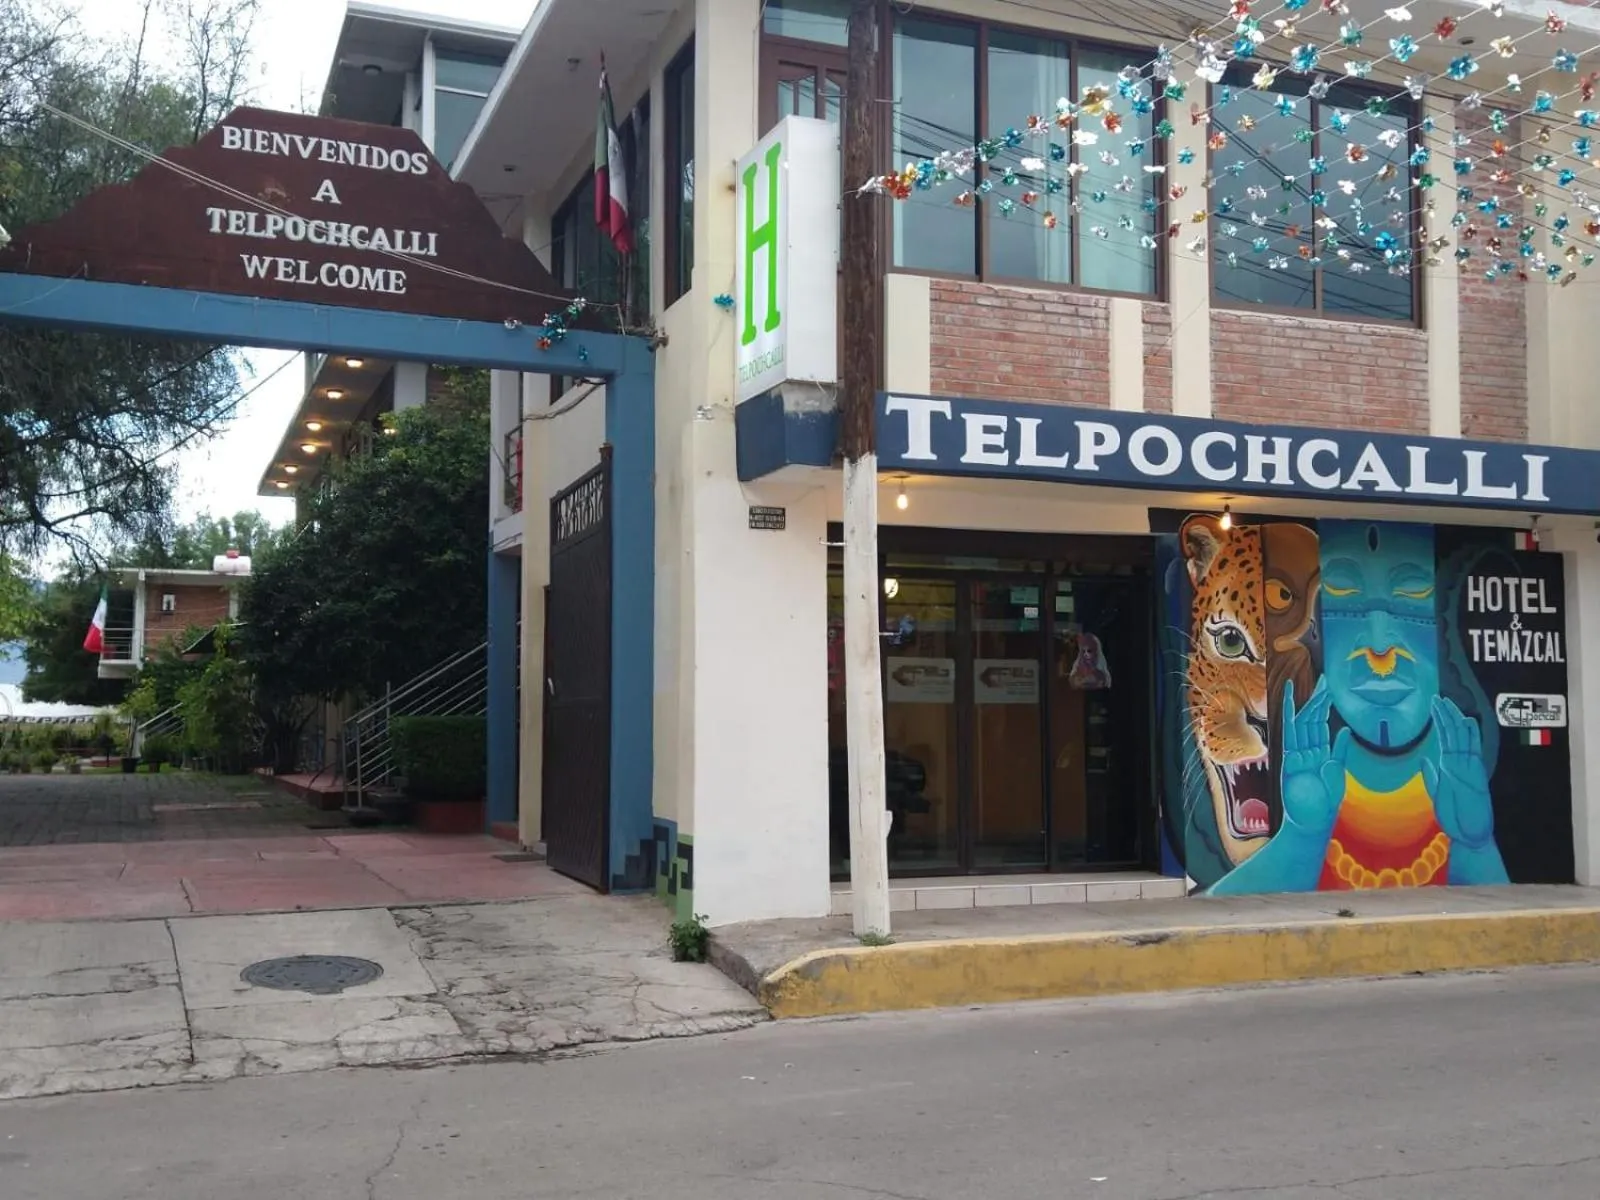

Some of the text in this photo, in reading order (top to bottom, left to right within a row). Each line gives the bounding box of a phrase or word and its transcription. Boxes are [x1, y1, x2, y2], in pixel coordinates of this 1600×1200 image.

[221, 126, 429, 175] BIENVENIDOS
[311, 179, 342, 205] A
[206, 207, 439, 257] TELPOCHCALLI
[742, 142, 782, 346] H
[240, 254, 407, 294] WELCOME
[885, 395, 1550, 502] TELPOCHCALLI
[1468, 575, 1556, 613] HOTEL
[1510, 613, 1522, 630] &
